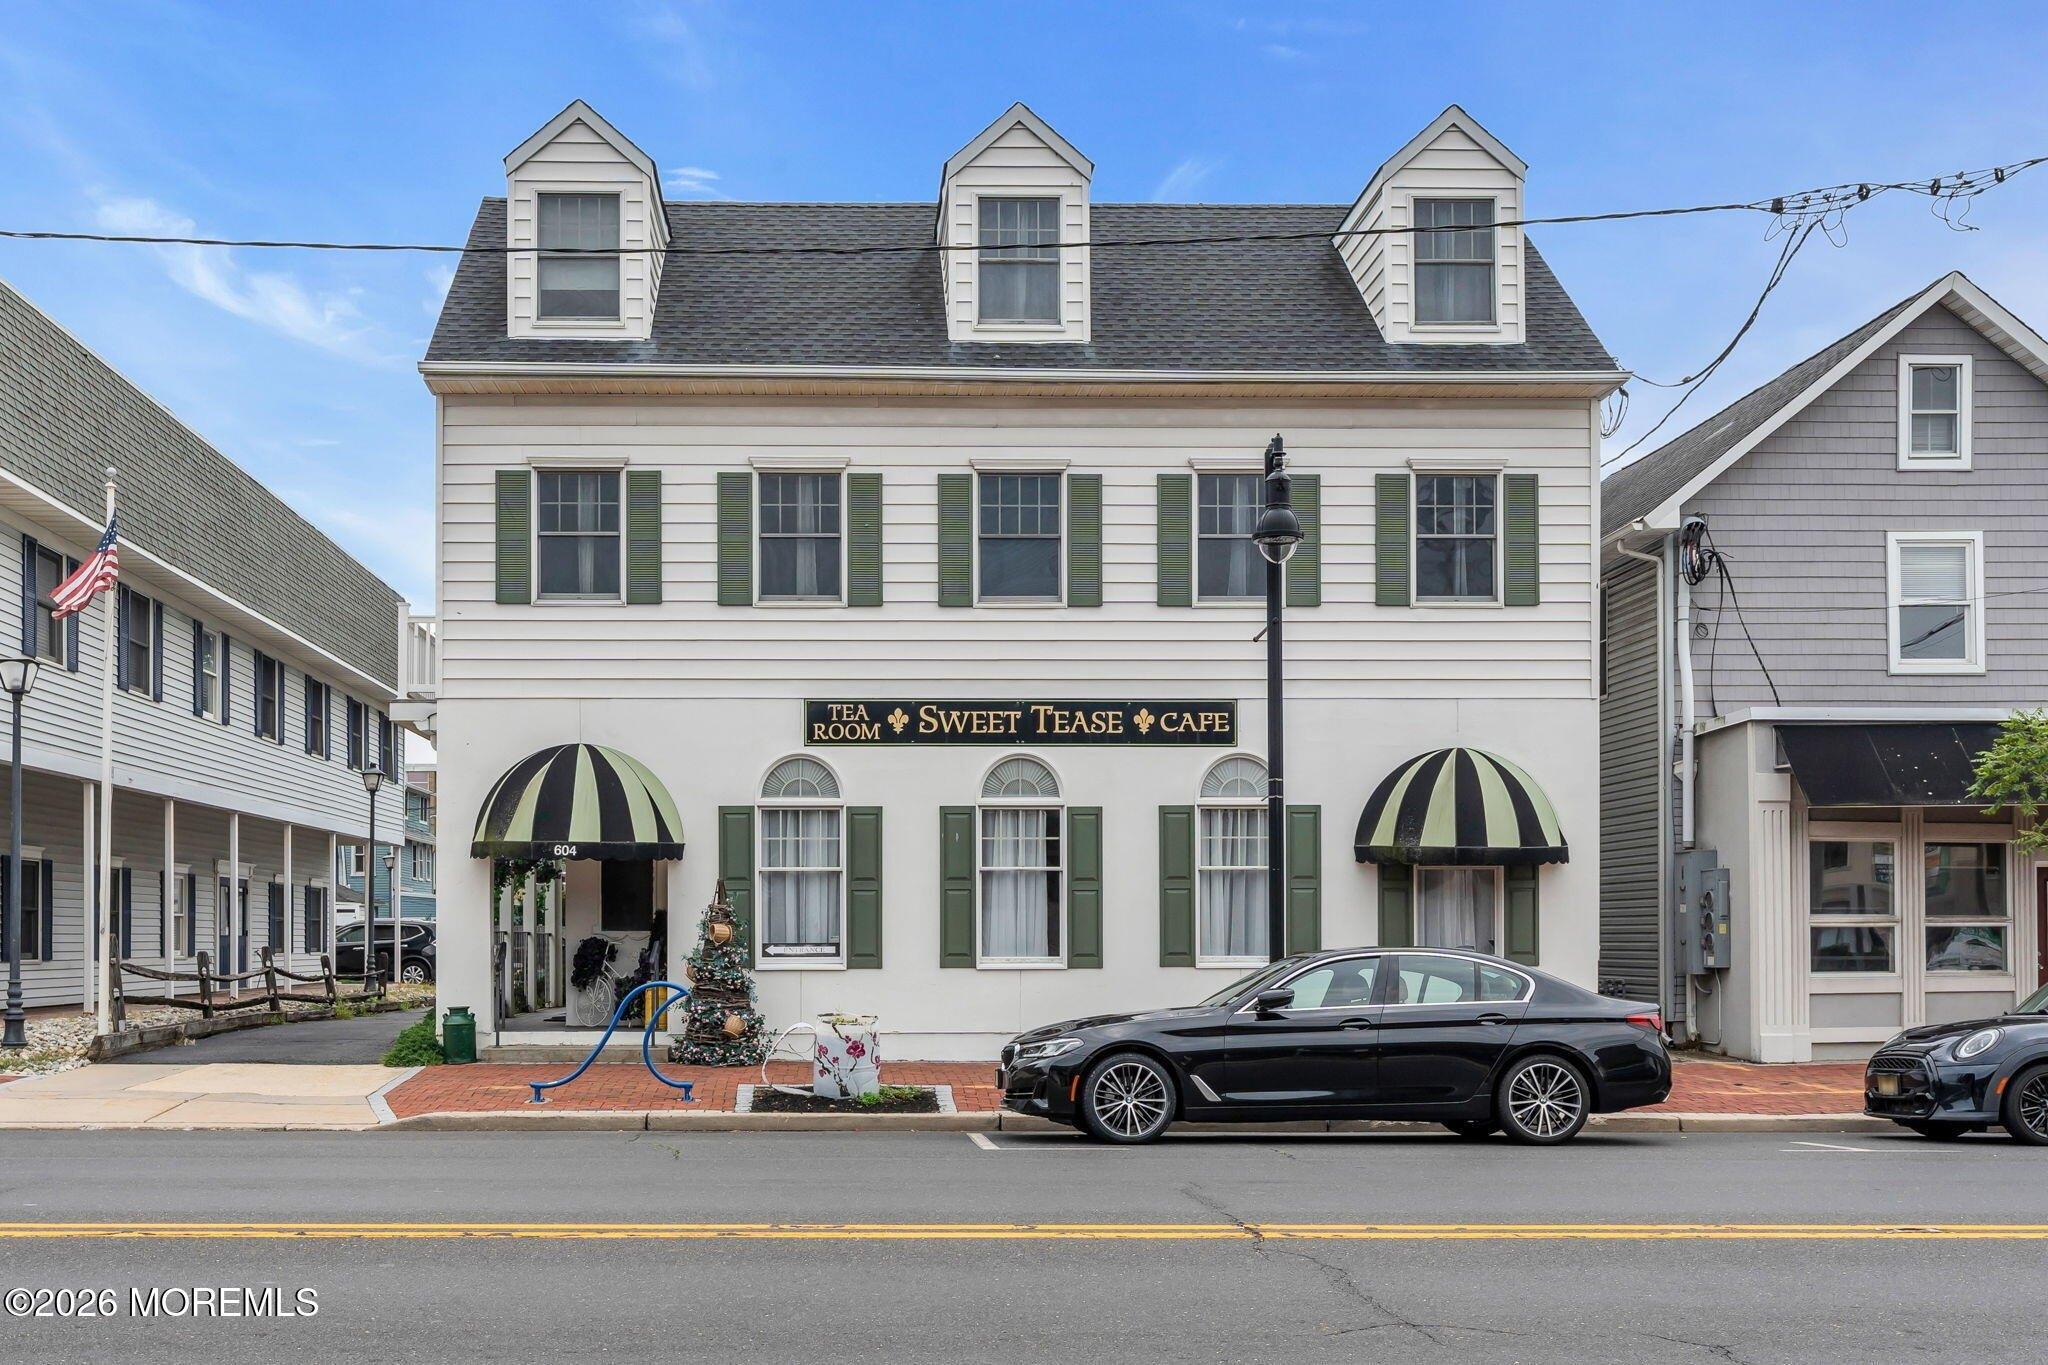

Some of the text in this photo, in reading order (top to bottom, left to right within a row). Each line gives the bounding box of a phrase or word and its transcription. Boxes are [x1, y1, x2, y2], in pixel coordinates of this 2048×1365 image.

[827, 704, 870, 721] TEA
[918, 705, 1124, 734] SWEET TEASE
[1159, 712, 1231, 733] CAFE
[812, 723, 882, 740] ROOM
[554, 844, 577, 856] 604
